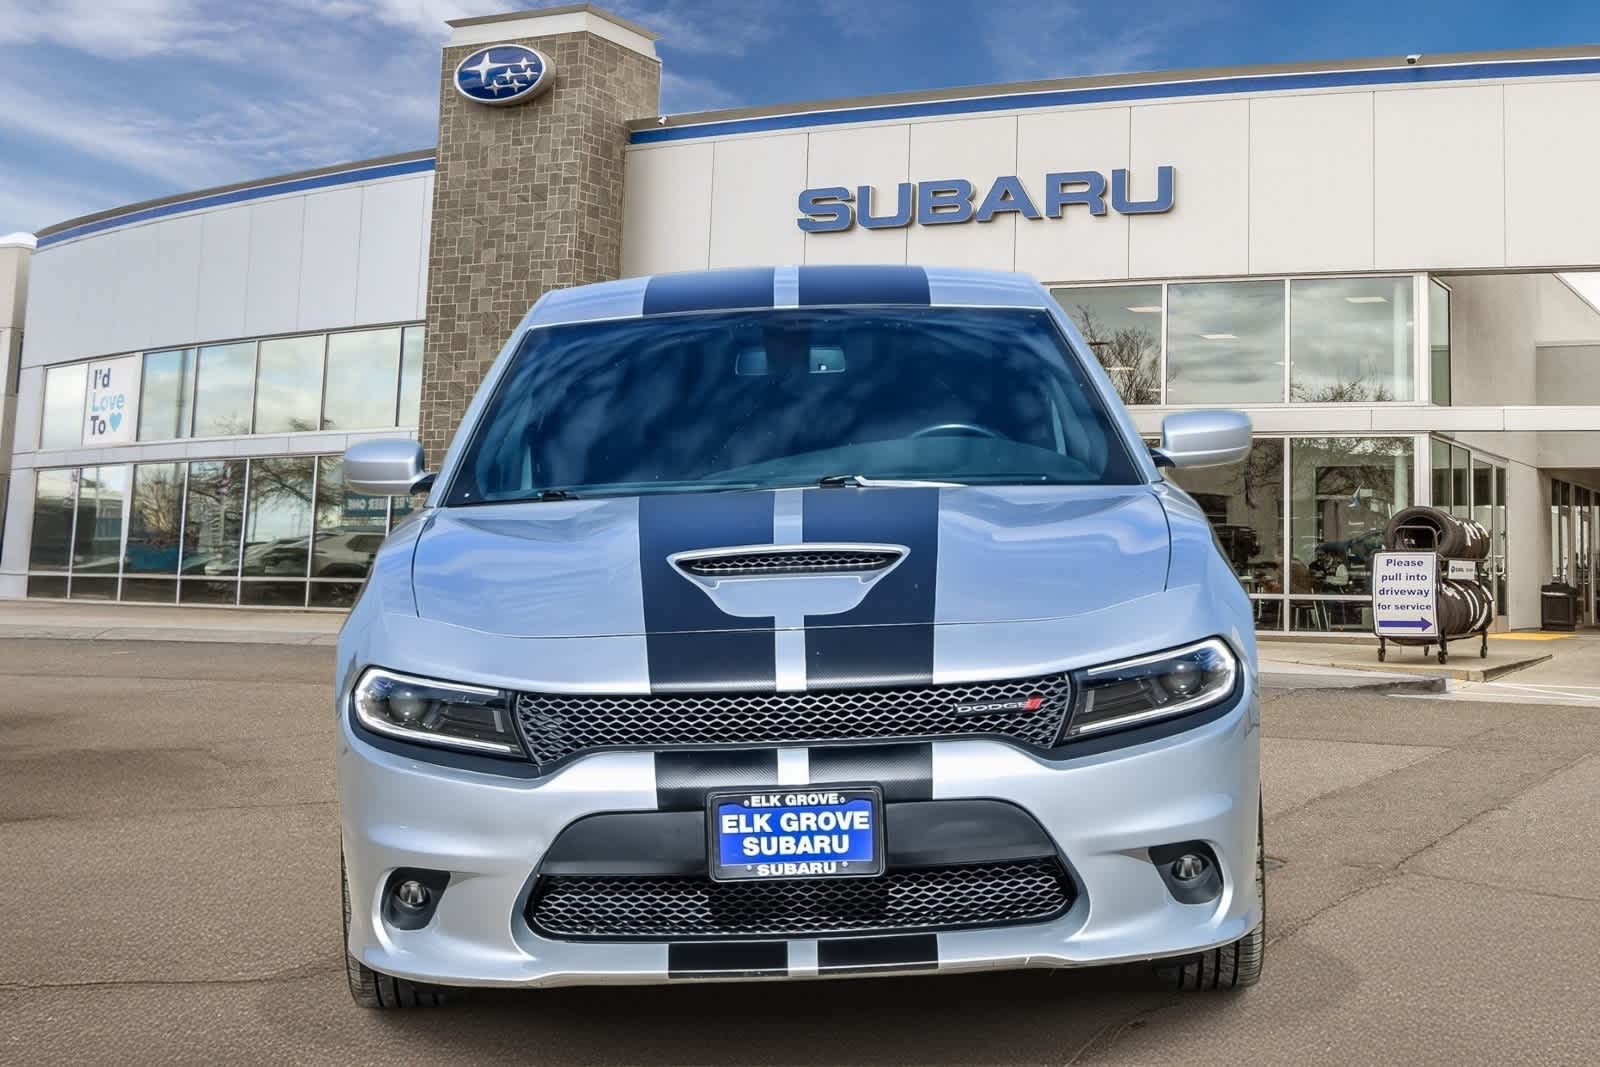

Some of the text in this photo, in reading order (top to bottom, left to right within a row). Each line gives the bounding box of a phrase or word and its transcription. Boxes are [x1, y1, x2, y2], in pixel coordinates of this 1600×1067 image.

[797, 165, 1175, 234] SUBARU
[93, 367, 111, 389] I'd
[91, 391, 126, 412] Love
[90, 415, 106, 435] To
[1386, 558, 1424, 567] Please
[1381, 573, 1428, 583] pull into
[1378, 587, 1429, 597] driveway
[957, 702, 1026, 713] DODGE
[751, 793, 839, 807] ELK GROVE
[721, 810, 870, 834] ELK GROVE
[742, 835, 849, 856] SUBARU
[757, 862, 837, 876] SUBARU
